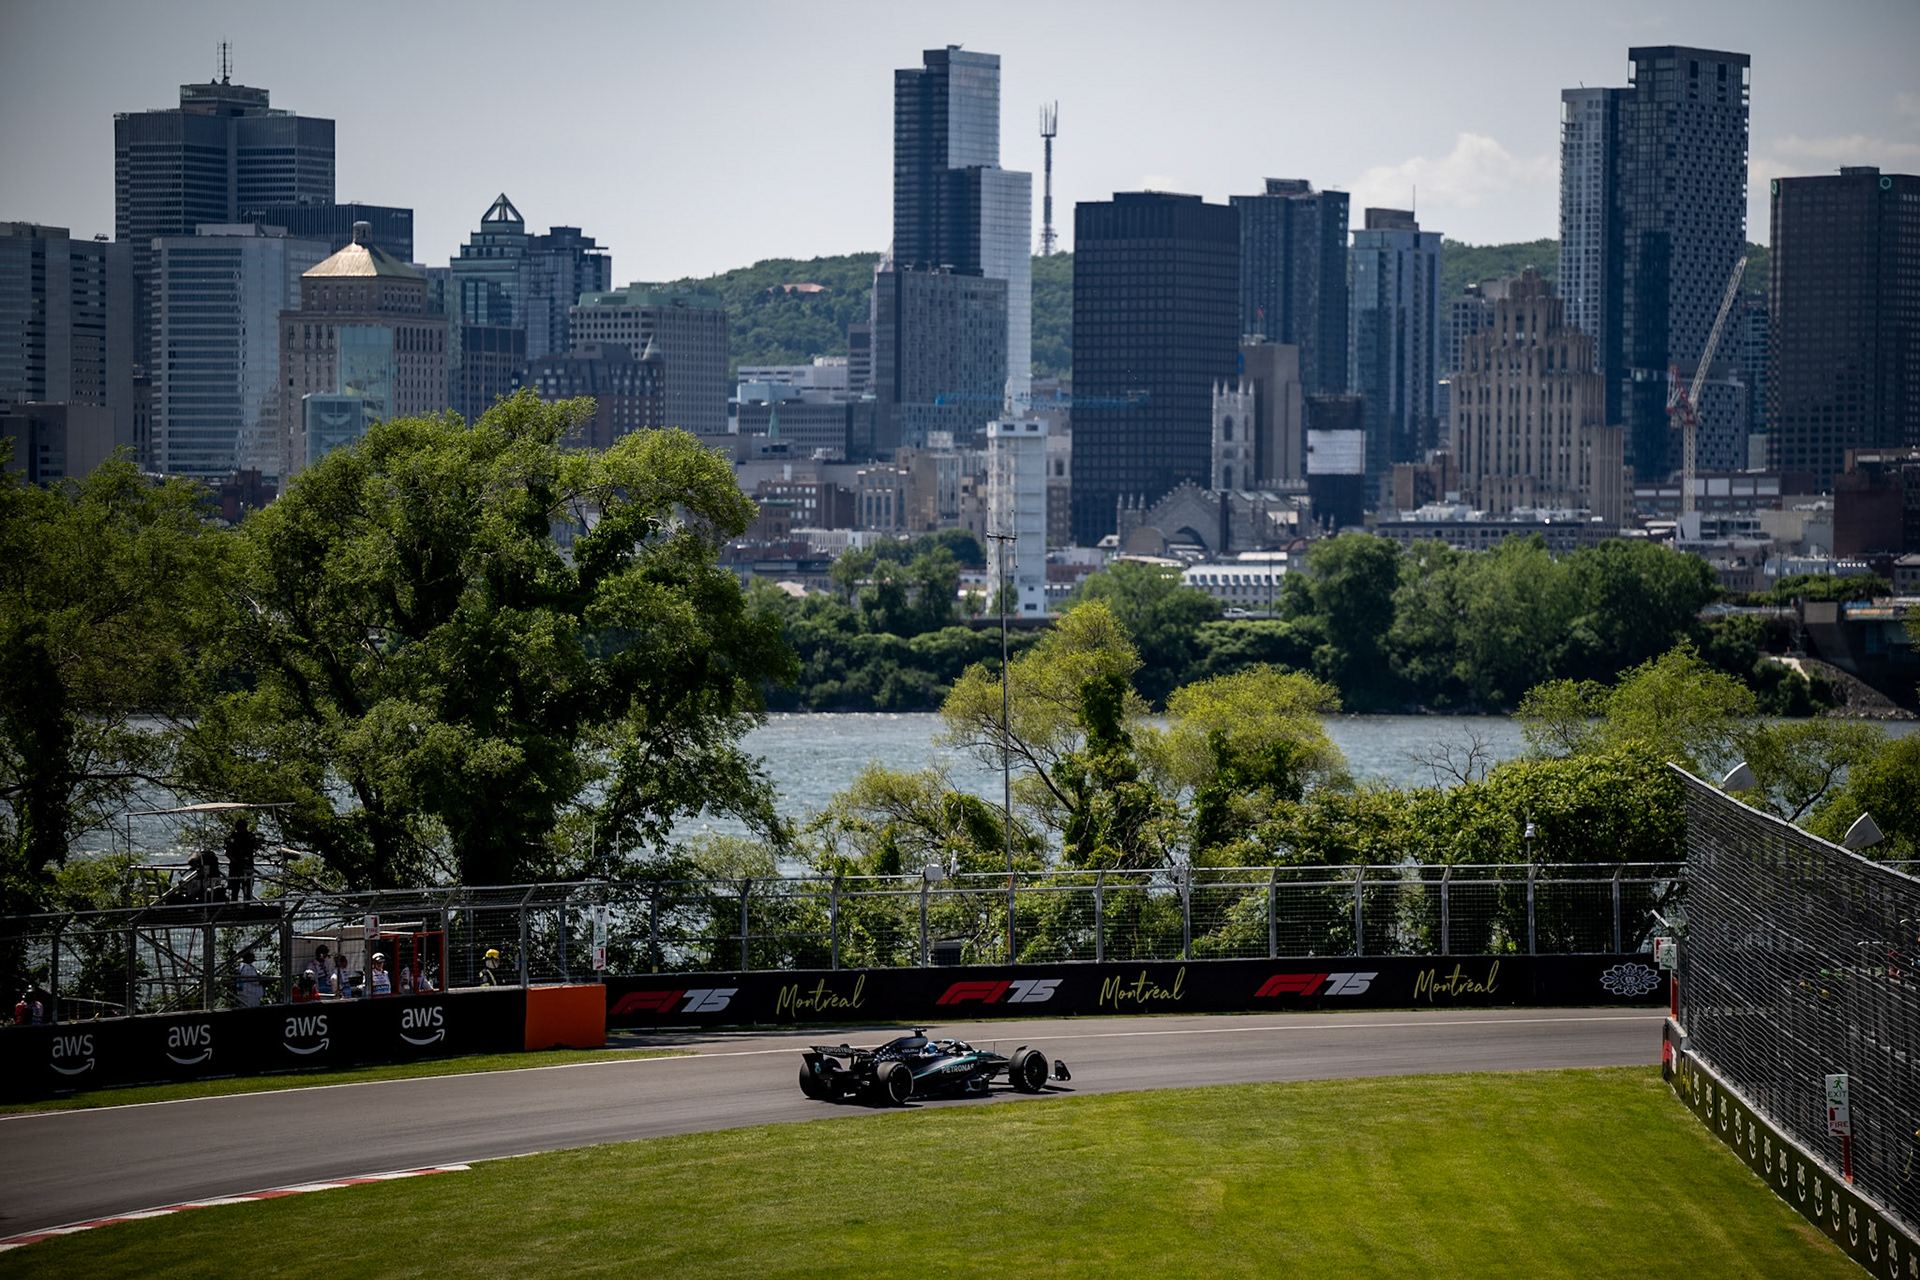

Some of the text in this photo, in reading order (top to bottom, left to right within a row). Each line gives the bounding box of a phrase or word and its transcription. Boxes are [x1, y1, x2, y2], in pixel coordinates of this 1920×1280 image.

[936, 979, 1063, 1005] F1 75
[1100, 967, 1186, 1009] Montréal
[1254, 972, 1379, 997] F1 75
[1414, 960, 1500, 1002] Montréal
[607, 988, 739, 1014] F1 75
[776, 974, 866, 1018] Montréal
[285, 1015, 328, 1038] aws
[402, 1005, 444, 1029] aws
[52, 1034, 94, 1058] aws
[168, 1024, 212, 1047] aws
[941, 1063, 975, 1074] PETRONAS
[1827, 1090, 1847, 1098] EXIT
[1829, 1120, 1849, 1128] FIRE
